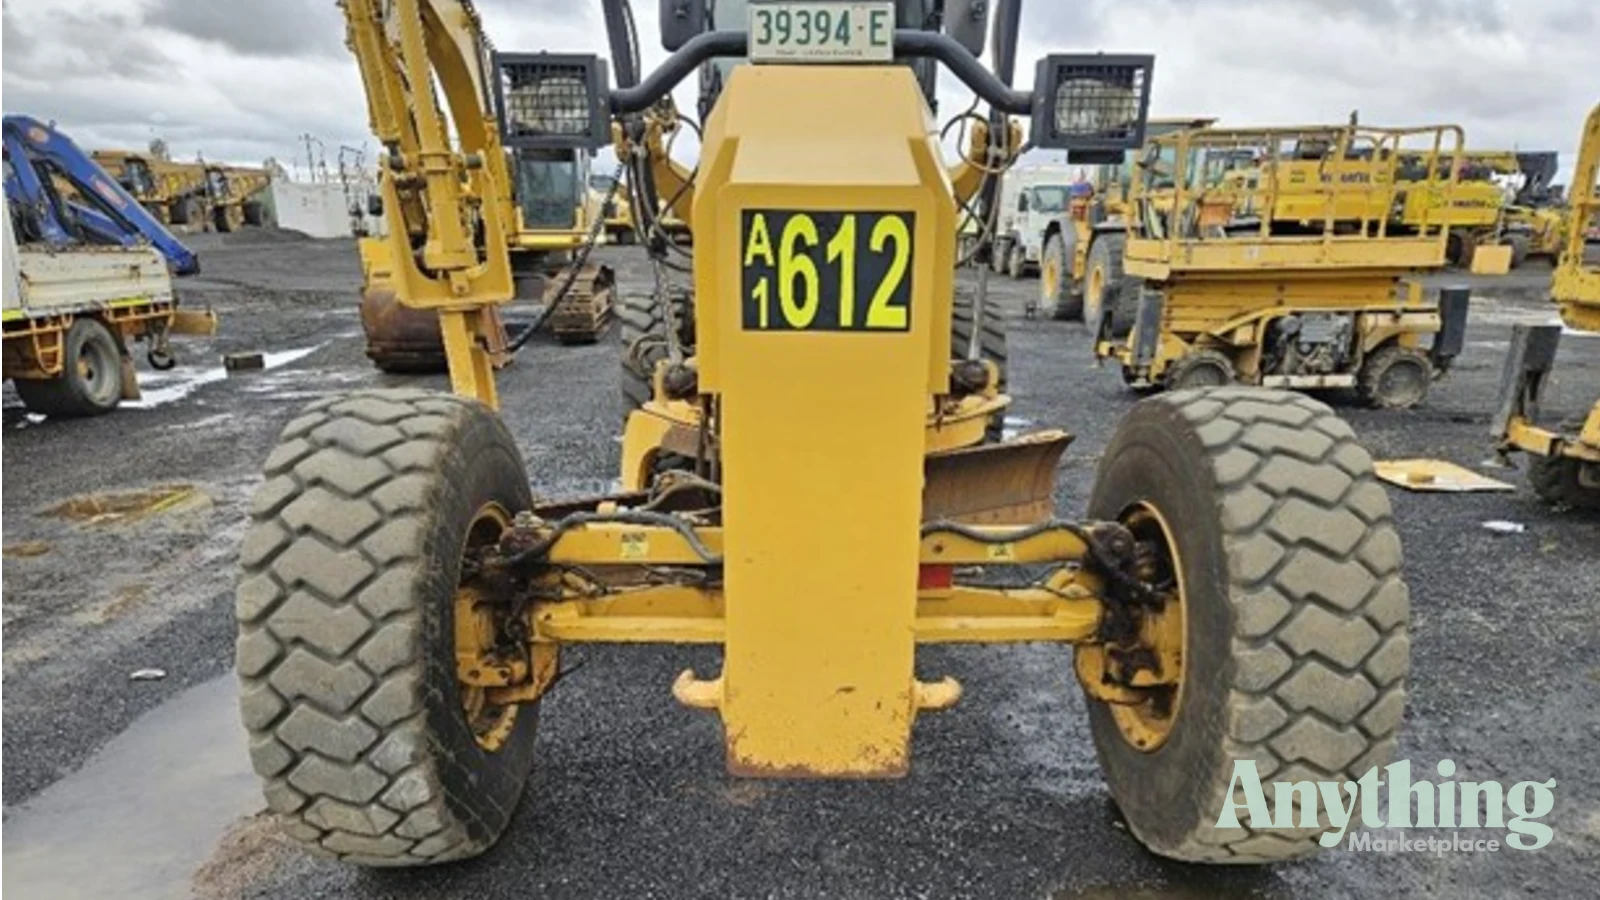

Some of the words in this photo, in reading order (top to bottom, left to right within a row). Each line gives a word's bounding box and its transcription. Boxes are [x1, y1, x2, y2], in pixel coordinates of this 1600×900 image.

[744, 213, 775, 266] A
[778, 213, 910, 328] 612
[752, 276, 768, 329] 1
